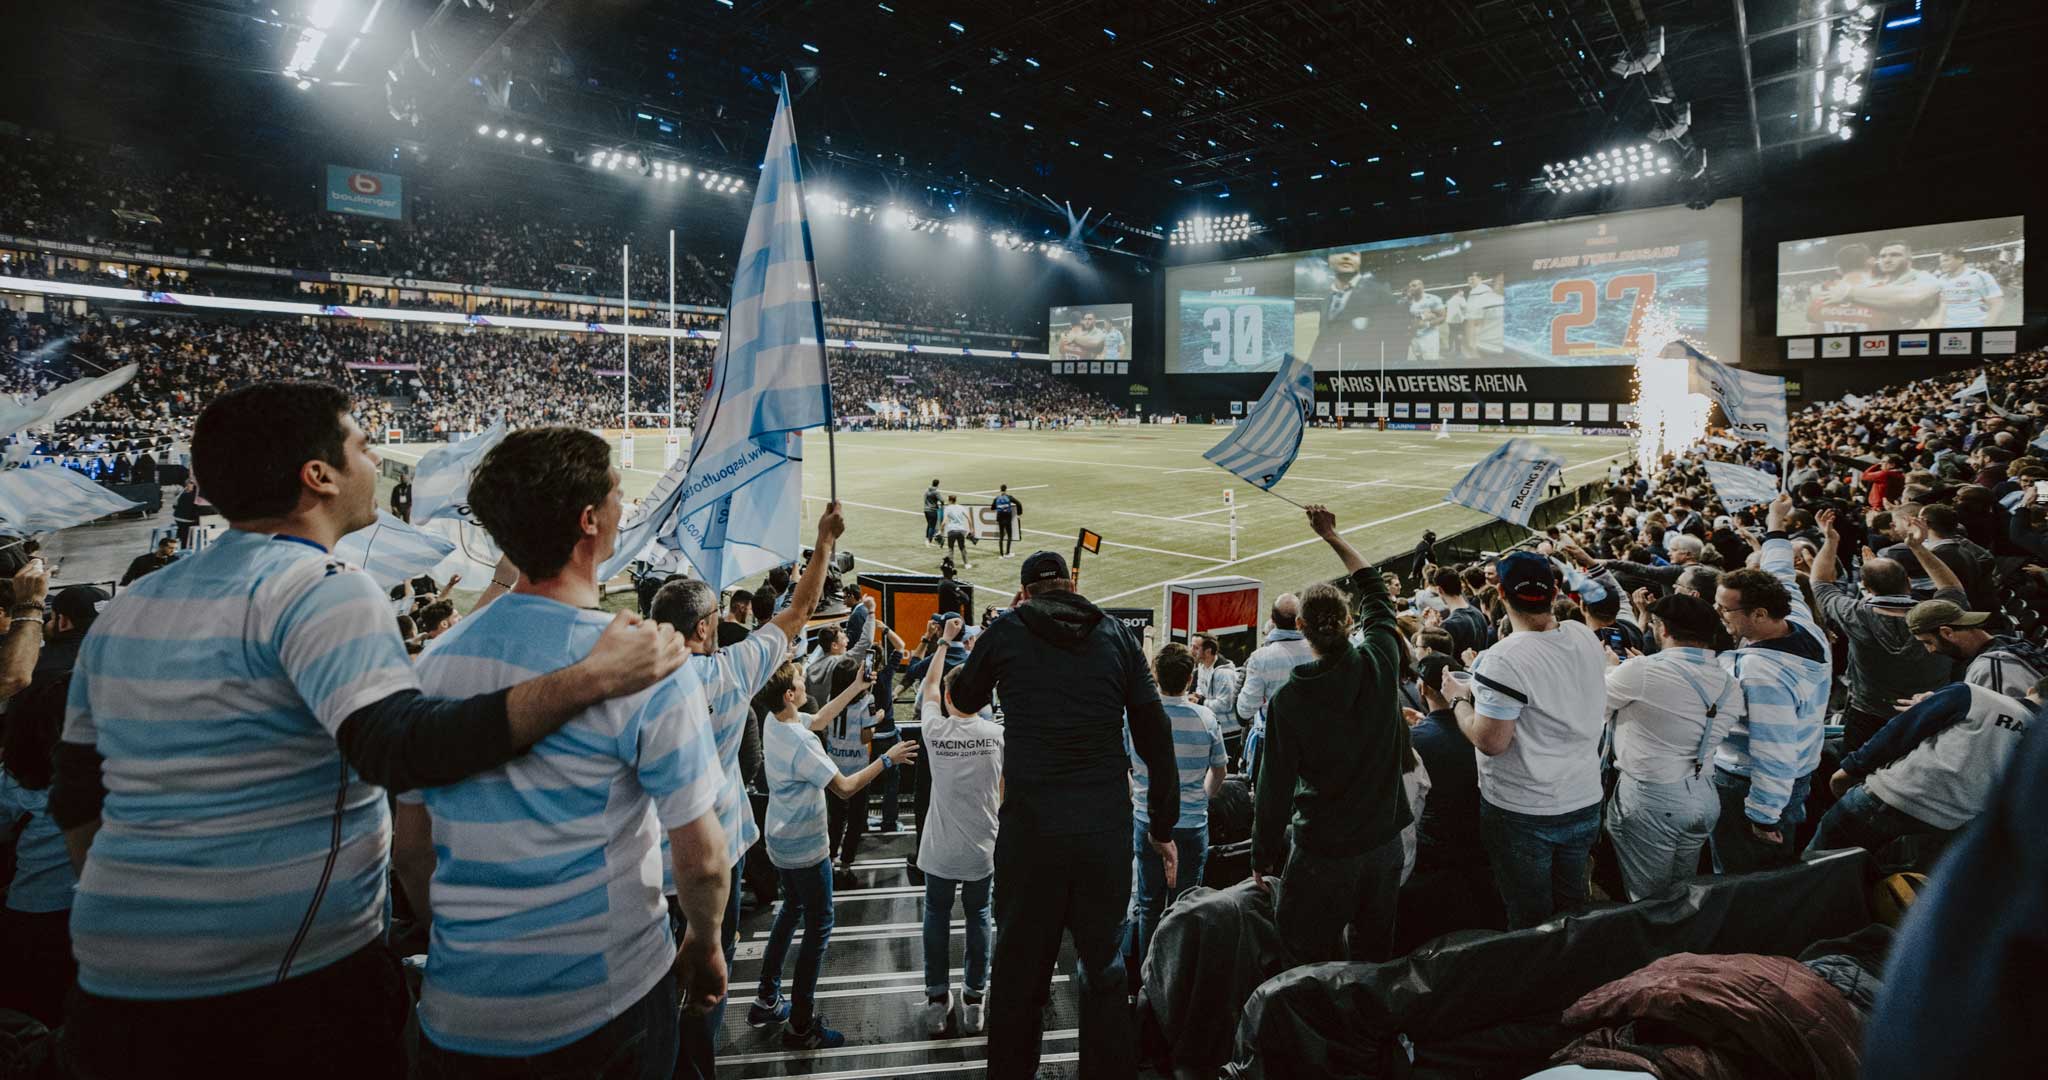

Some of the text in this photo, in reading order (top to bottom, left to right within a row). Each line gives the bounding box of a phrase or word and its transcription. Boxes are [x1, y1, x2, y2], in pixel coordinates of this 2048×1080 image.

[331, 191, 397, 207] boulanger
[1552, 273, 1657, 356] 27
[1203, 304, 1263, 366] 30
[1329, 376, 1375, 393] PARIS
[1375, 376, 1397, 393] LA
[1396, 375, 1472, 393] DEFENSE
[1474, 374, 1528, 393] ARENA
[1511, 473, 1539, 510] RACING
[930, 738, 1000, 750] RACINGMEN
